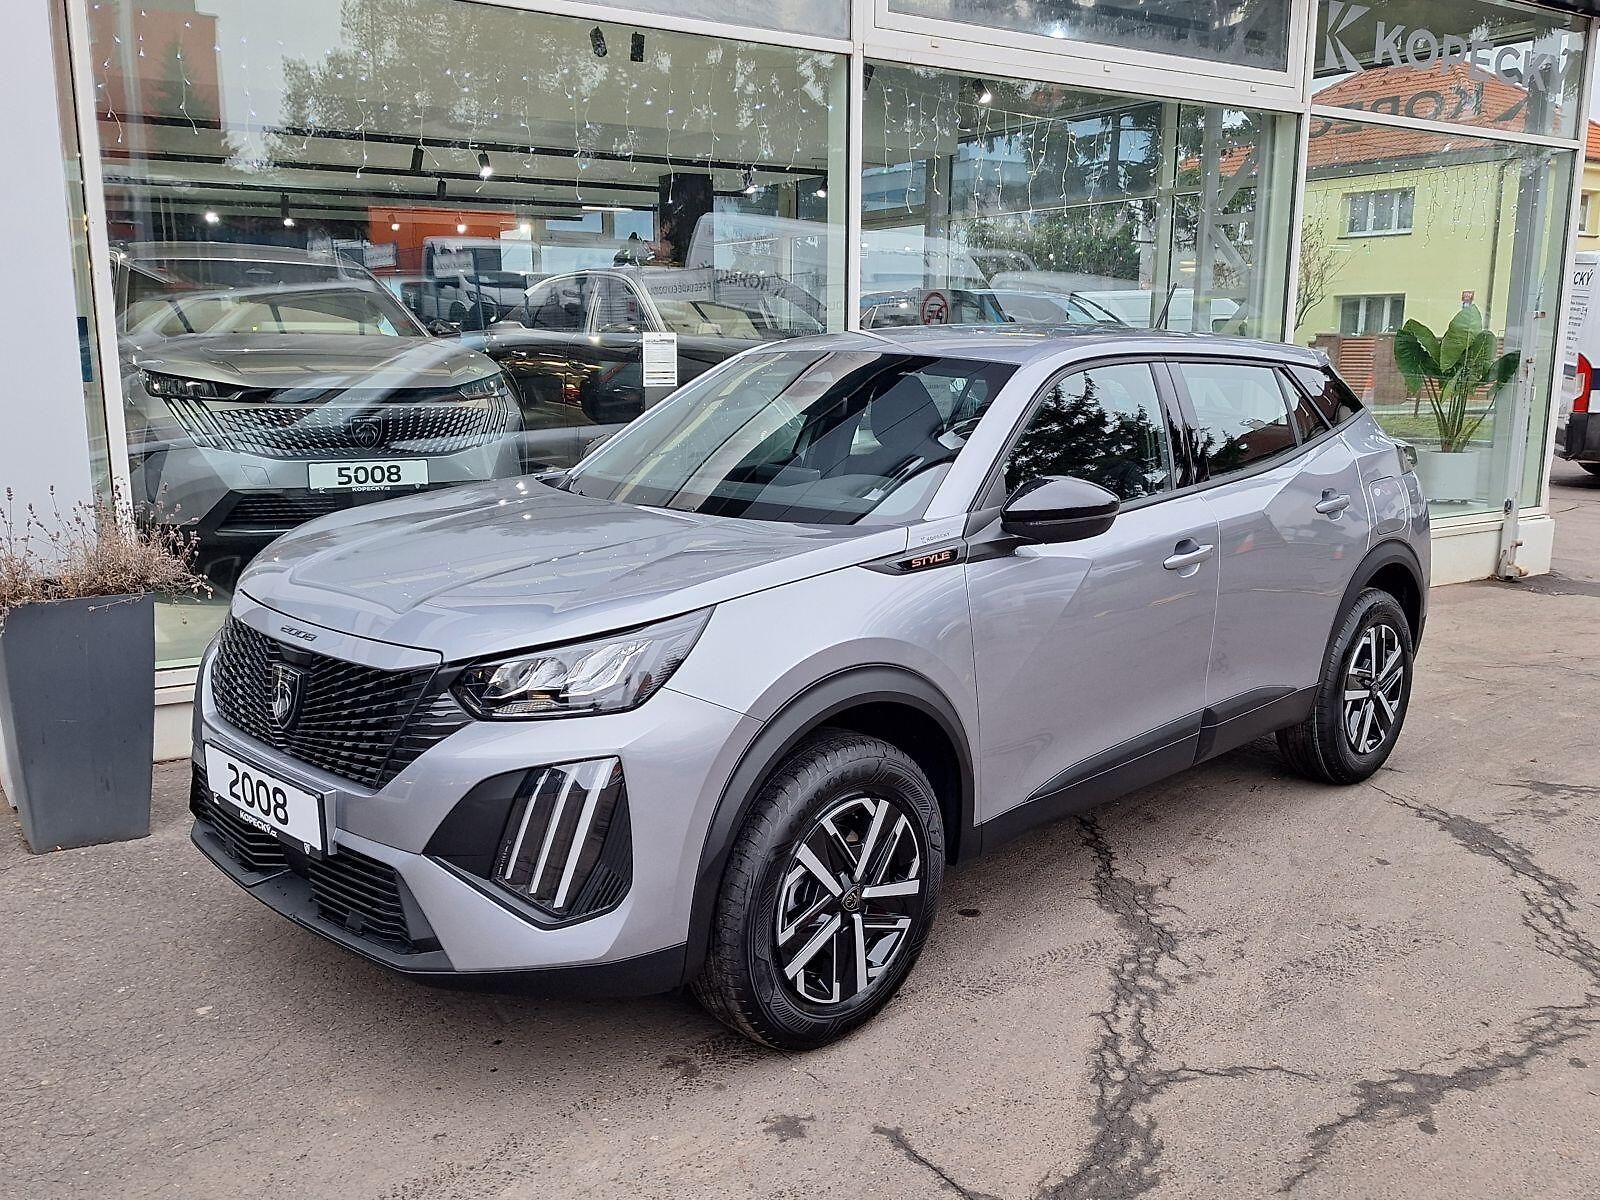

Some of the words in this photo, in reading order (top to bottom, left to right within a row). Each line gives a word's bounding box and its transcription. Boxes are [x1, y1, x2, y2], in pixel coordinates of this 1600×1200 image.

[337, 464, 402, 486] 5008
[911, 551, 951, 568] STYLE
[280, 625, 318, 641] 2008
[227, 762, 289, 826] 2008
